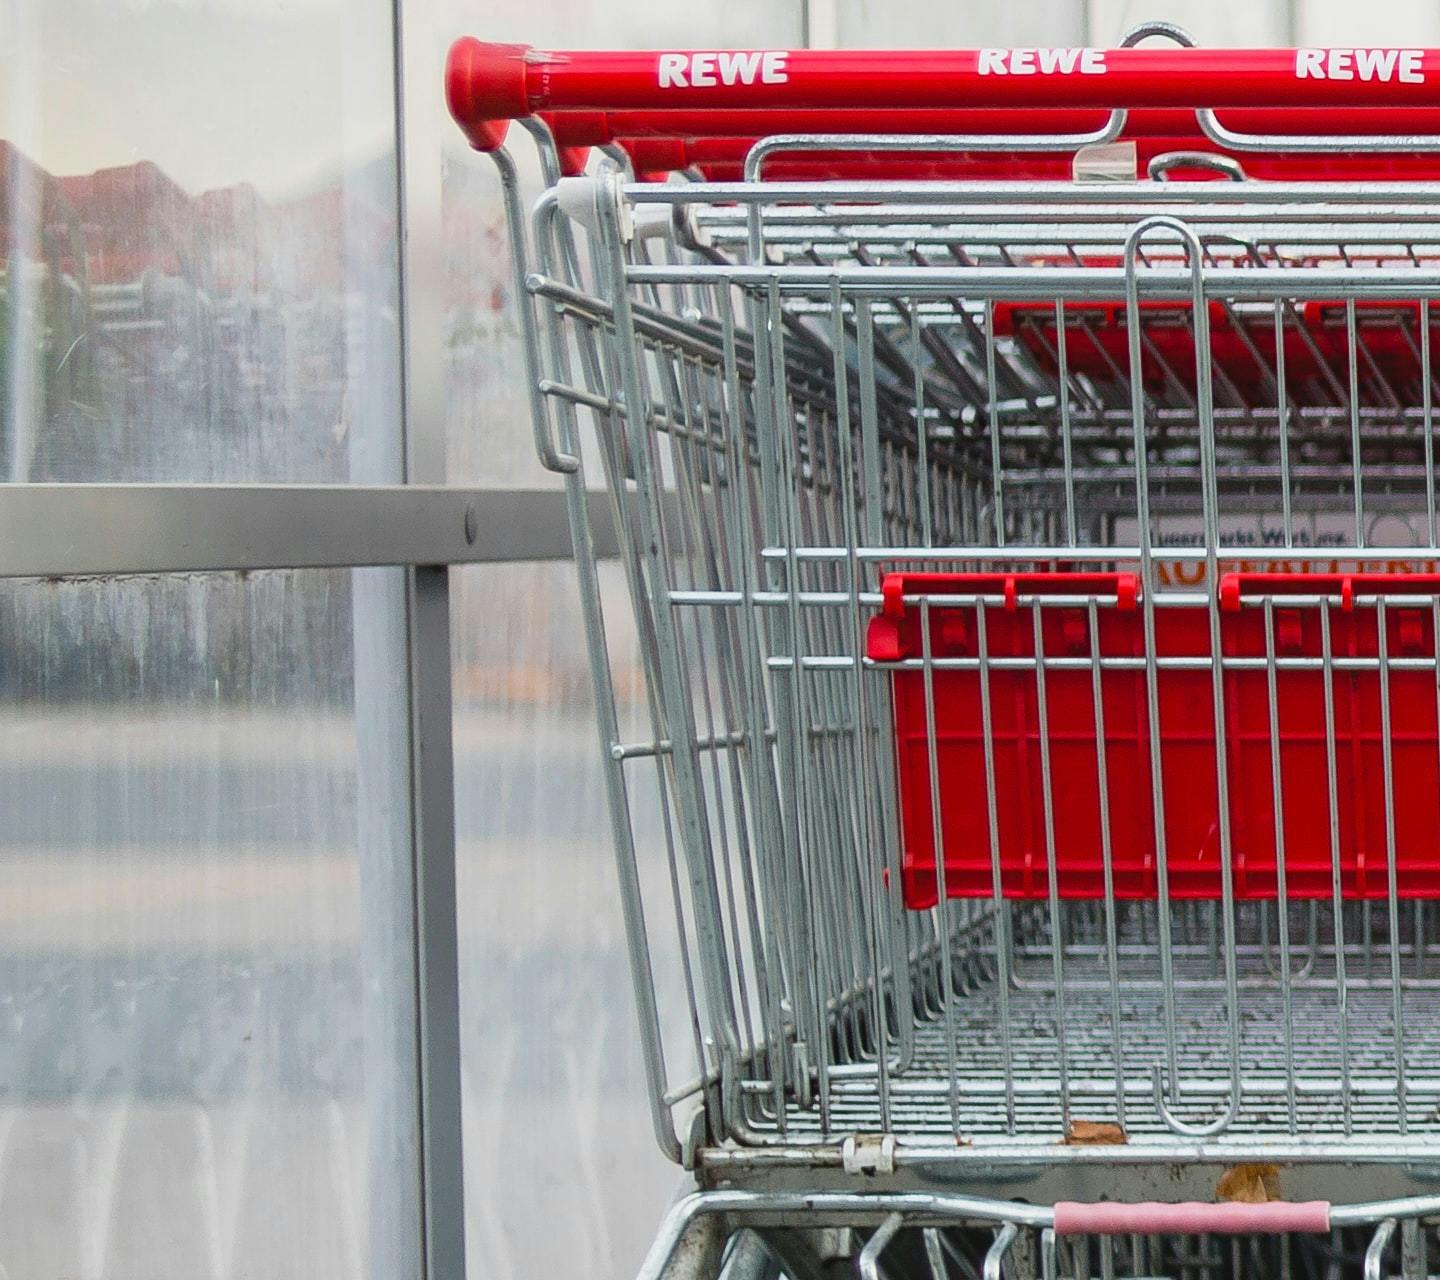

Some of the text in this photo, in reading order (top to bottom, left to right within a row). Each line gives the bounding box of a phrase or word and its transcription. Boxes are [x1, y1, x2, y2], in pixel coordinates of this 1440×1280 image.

[658, 48, 1425, 87] REWE REWE REWE
